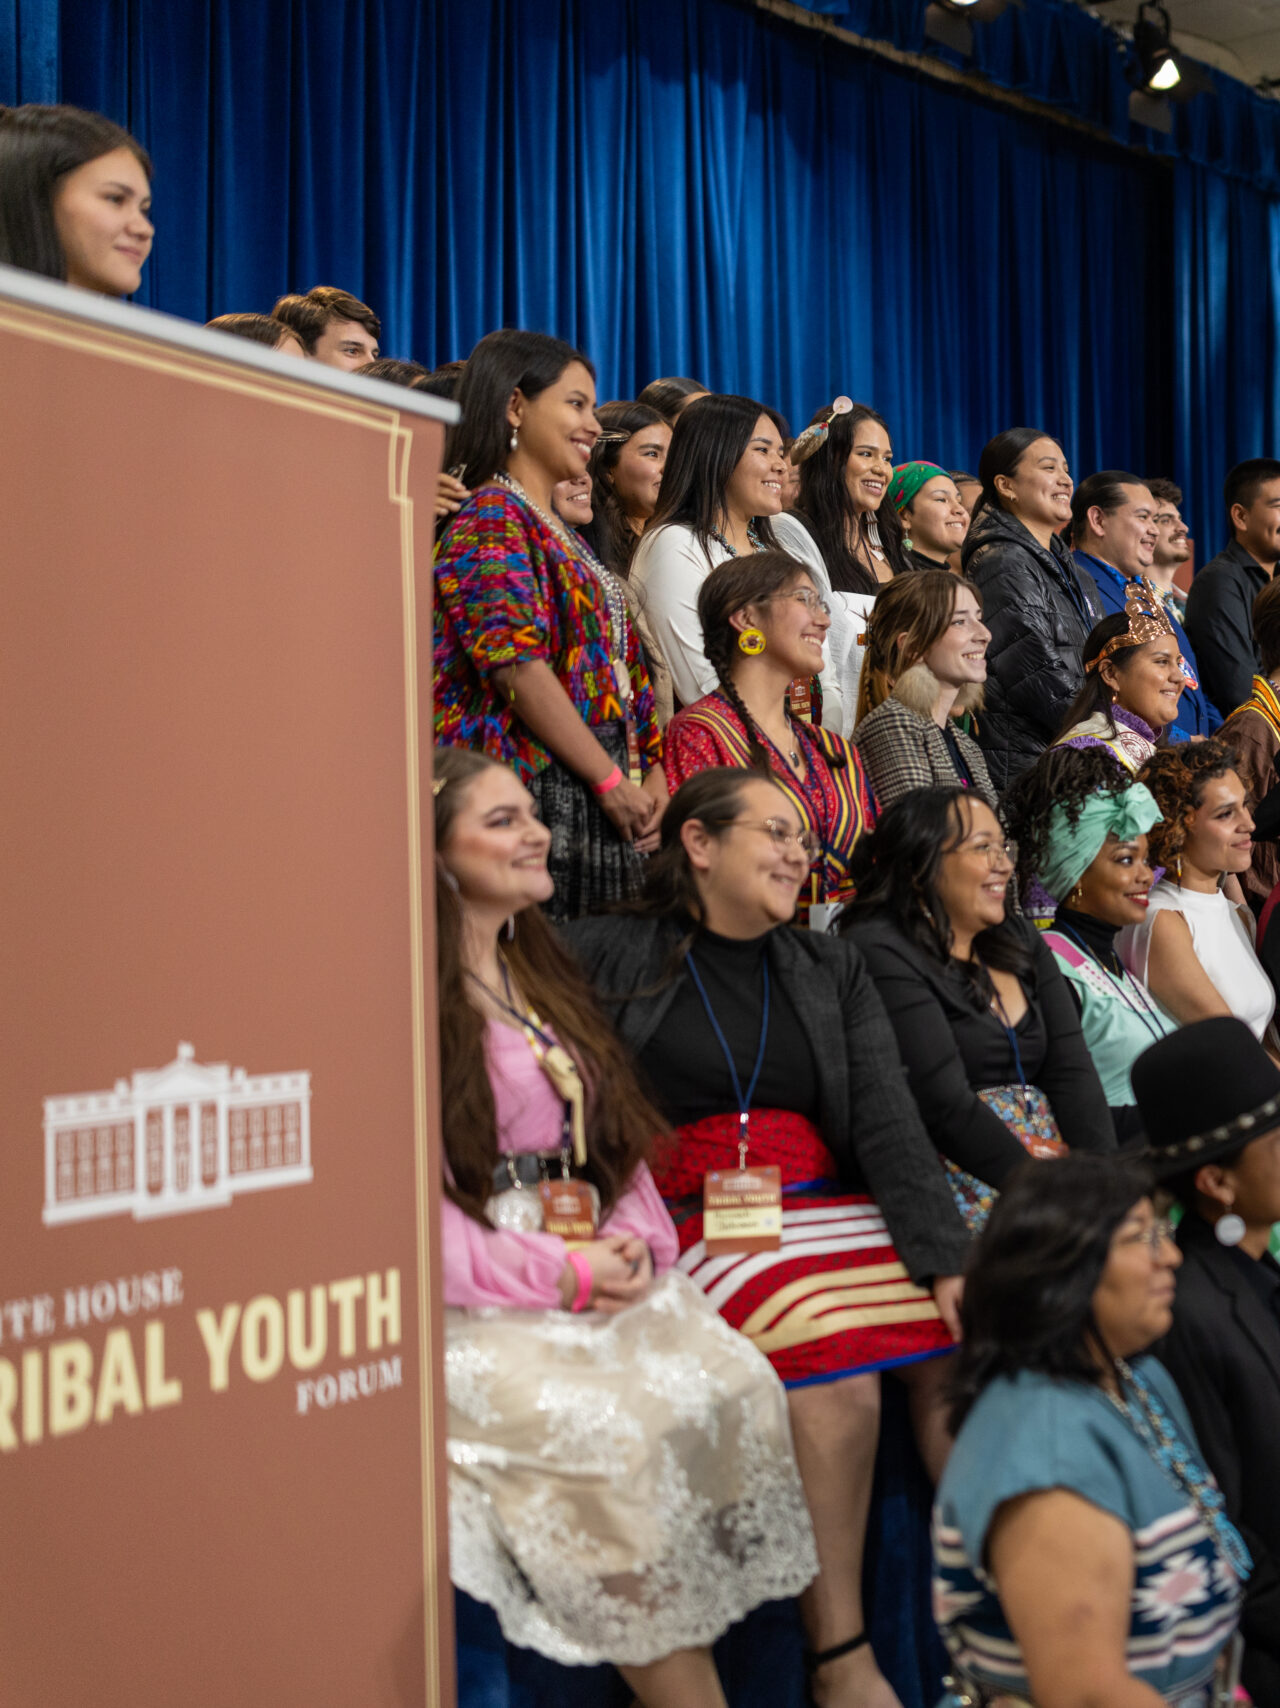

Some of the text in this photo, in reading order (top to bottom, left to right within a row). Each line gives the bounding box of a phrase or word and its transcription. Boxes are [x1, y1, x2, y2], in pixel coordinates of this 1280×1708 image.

[65, 1267, 184, 1328] HOUSE
[197, 1267, 402, 1391] YOUTH
[297, 1355, 402, 1415] FORUM
